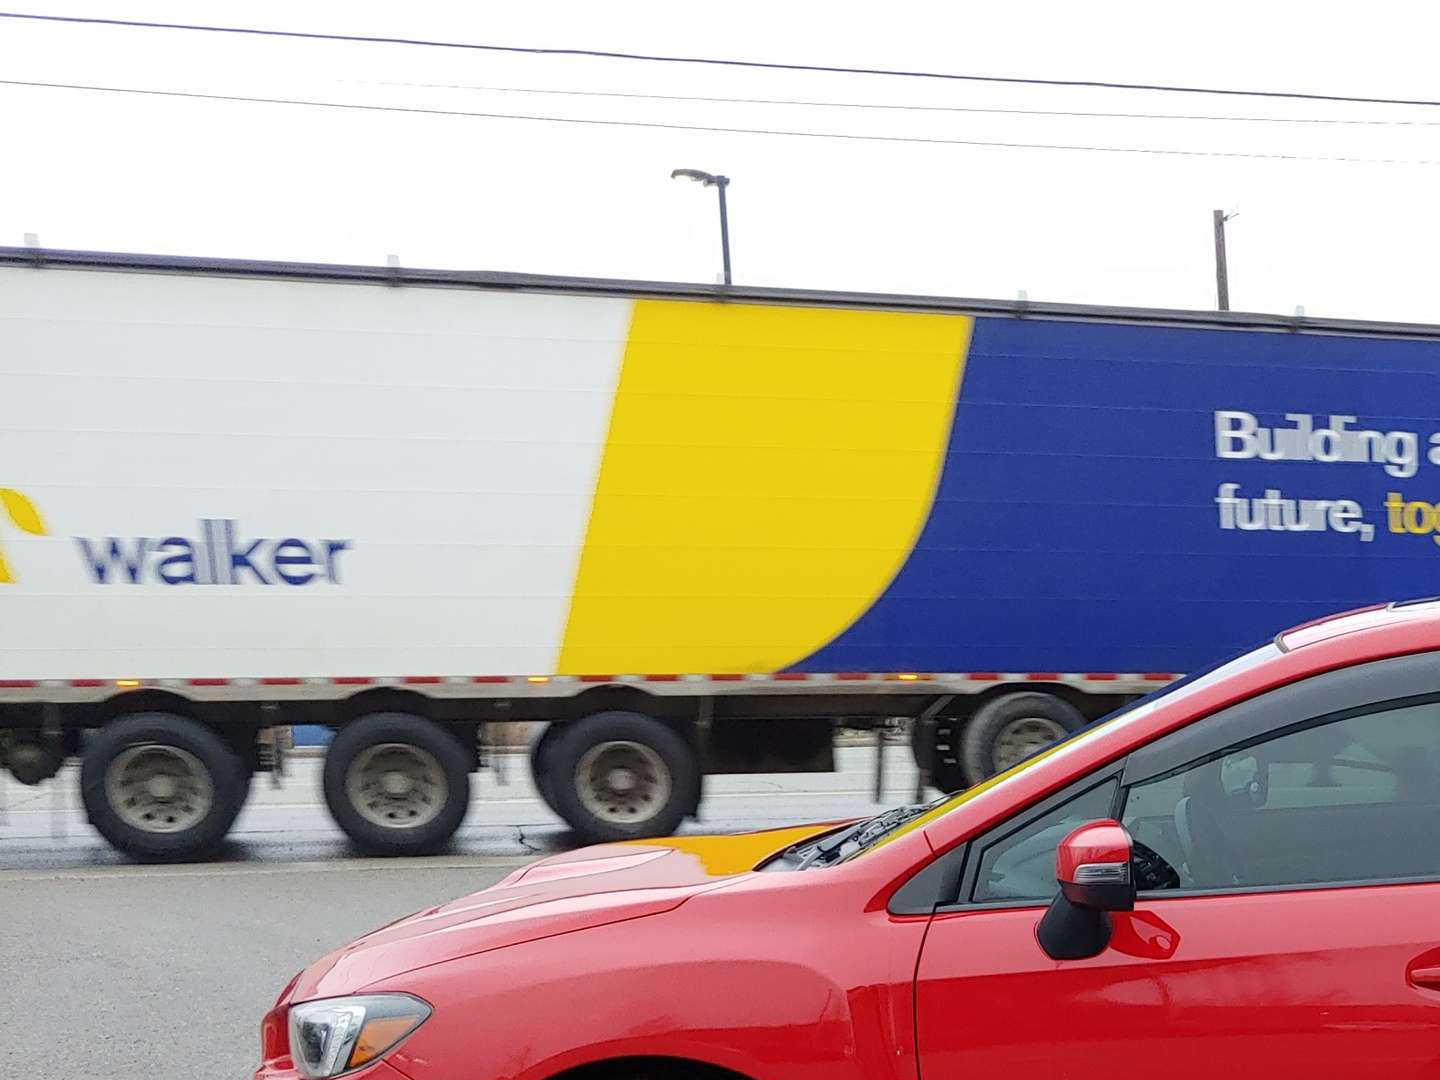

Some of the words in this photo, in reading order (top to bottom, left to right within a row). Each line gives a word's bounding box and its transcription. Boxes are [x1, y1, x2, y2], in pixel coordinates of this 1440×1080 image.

[1213, 410, 1419, 478] Building
[1214, 483, 1375, 542] future,
[70, 518, 354, 585] walker
